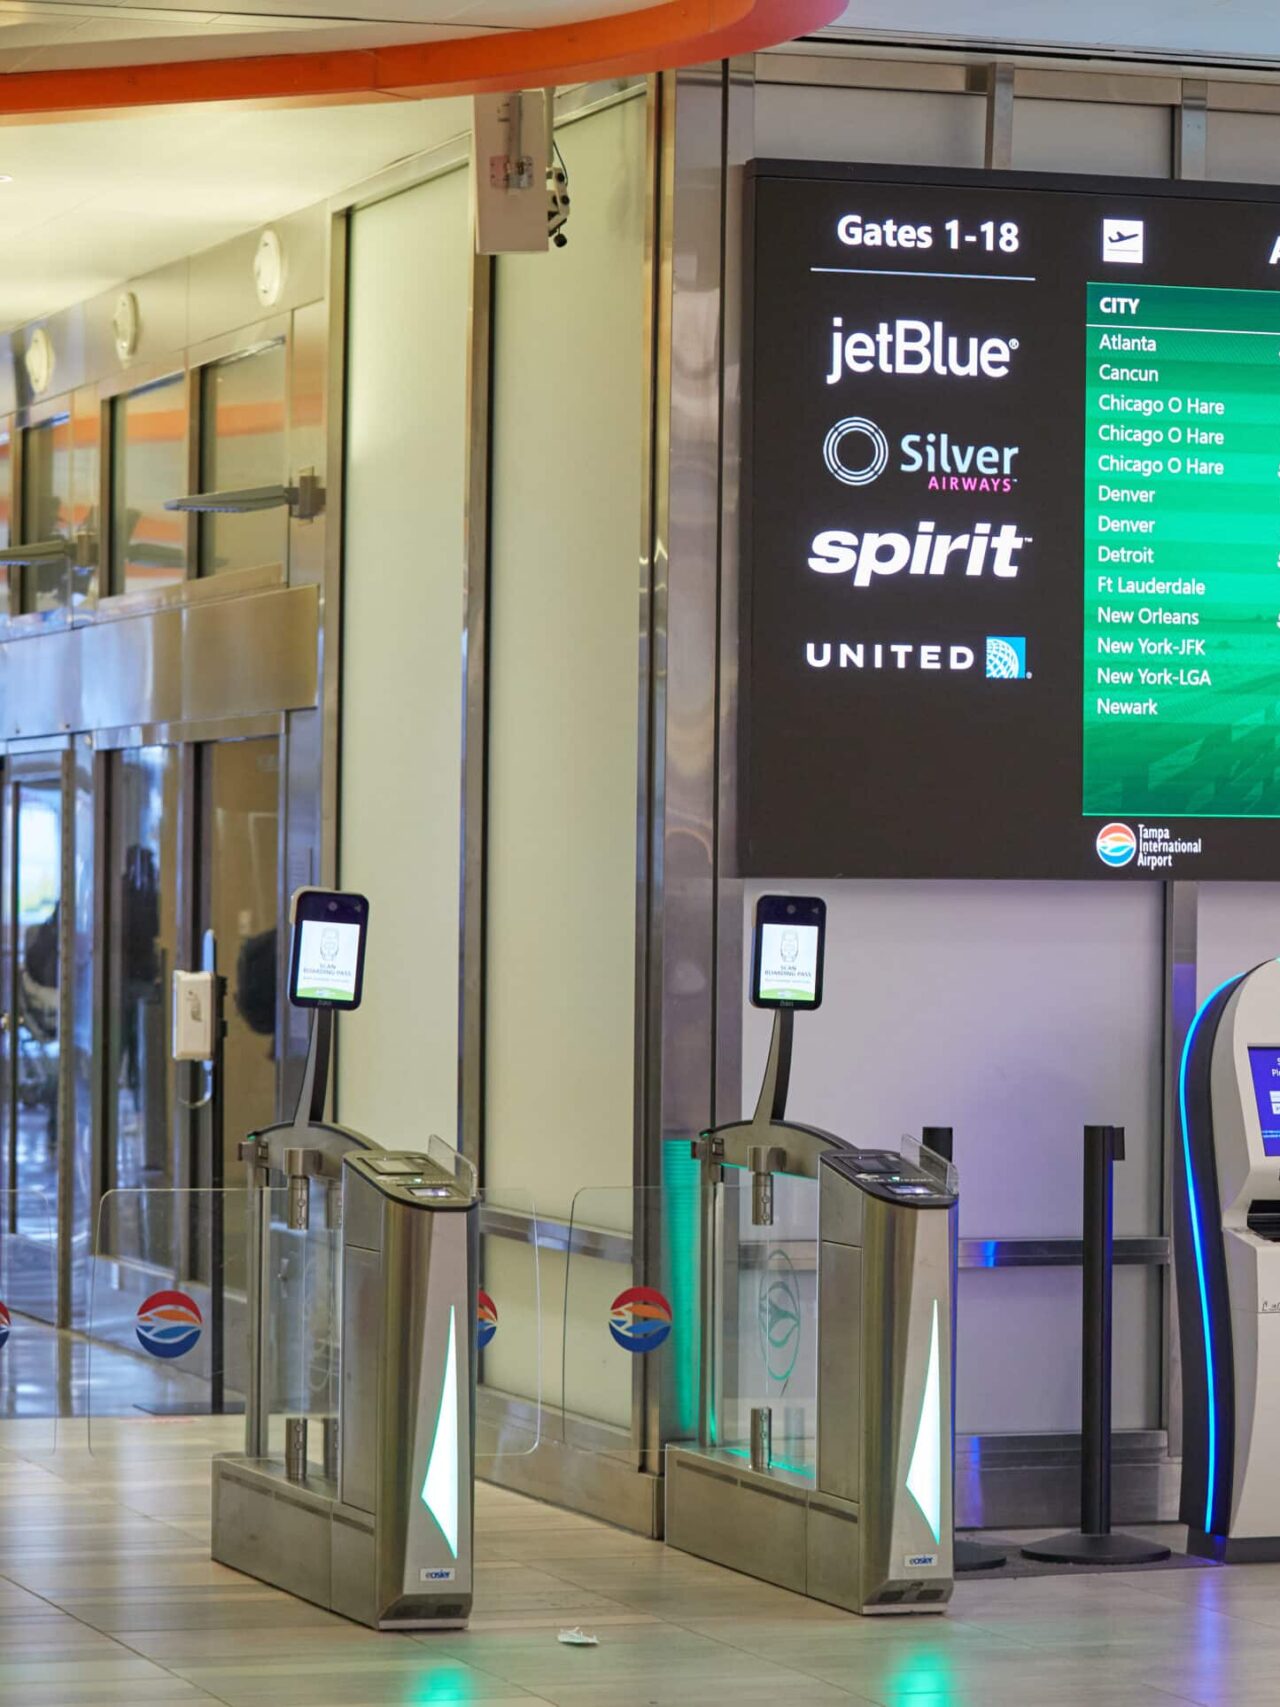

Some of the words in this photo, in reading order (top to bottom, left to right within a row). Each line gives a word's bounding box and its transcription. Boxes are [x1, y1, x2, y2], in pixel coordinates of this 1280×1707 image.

[837, 215, 933, 248] Gates
[945, 219, 1019, 253] 1-18
[1099, 297, 1140, 314] CITY
[826, 317, 1010, 385] jetBlue
[1099, 334, 1156, 352] Atlanta
[1099, 364, 1159, 382] Cancun
[1098, 394, 1164, 416] Chicago
[1168, 397, 1182, 413] O
[1187, 398, 1225, 415] Hare
[1098, 424, 1164, 447] Chicago
[1168, 427, 1182, 443] O
[1187, 427, 1224, 445] Hare
[901, 433, 1019, 475] Silver
[1098, 454, 1164, 477] Chicago
[1167, 457, 1182, 474] O
[1186, 458, 1224, 475] Hare
[928, 476, 1011, 492] AIRWAYS
[1098, 485, 1156, 503] Denver
[1098, 515, 1156, 533] Denver
[808, 521, 1024, 587] spirit
[1098, 545, 1154, 563] Detroit
[1098, 576, 1113, 593] Ft
[1118, 577, 1206, 595] Lauderdale
[1098, 607, 1134, 623] New
[1138, 607, 1199, 625] Orleans
[1097, 637, 1134, 654] New
[1138, 638, 1205, 655] York-JFK
[806, 643, 974, 670] UNITED
[1097, 667, 1134, 684] New
[1138, 668, 1211, 686] York-LGA
[1097, 698, 1158, 715] Newark
[1138, 824, 1169, 839] Tampa
[1139, 838, 1201, 853] International
[1138, 853, 1172, 870] Airport
